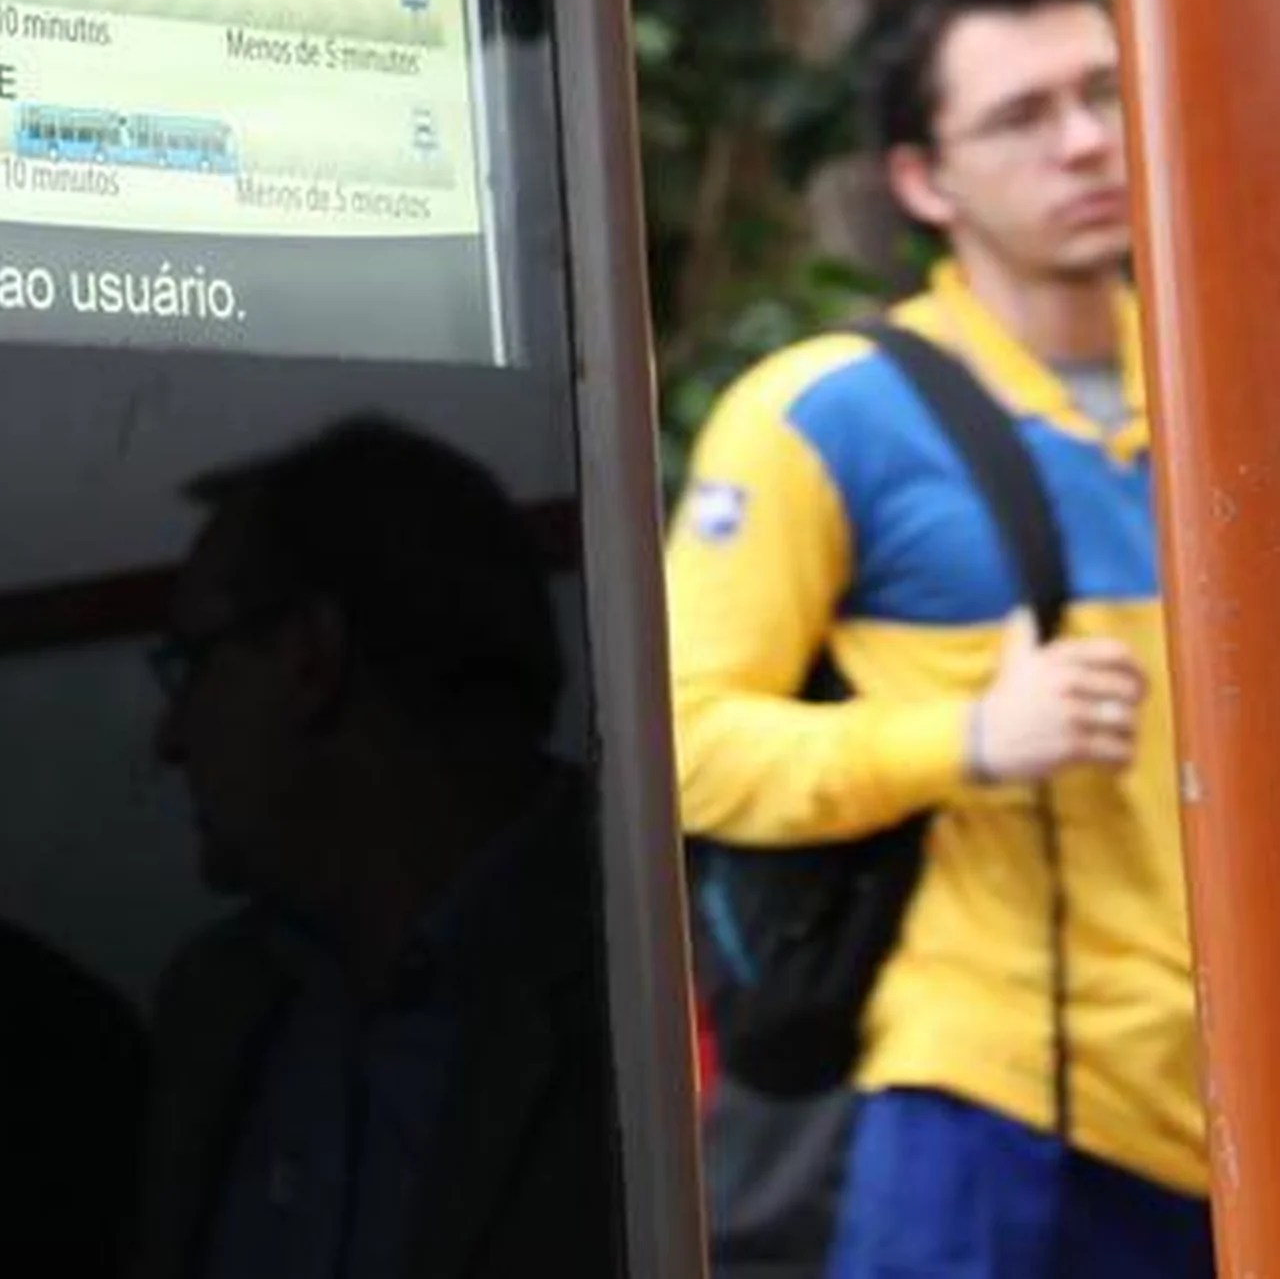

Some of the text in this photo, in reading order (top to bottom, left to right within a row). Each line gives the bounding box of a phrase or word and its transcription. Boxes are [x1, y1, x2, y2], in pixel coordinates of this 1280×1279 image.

[23, 7, 112, 46] minutos
[225, 27, 292, 66] Menos
[295, 35, 320, 68] de
[3, 156, 120, 197] 10 minutos
[236, 176, 303, 210] Menos
[306, 181, 331, 213] de
[70, 260, 247, 322] usuário.
